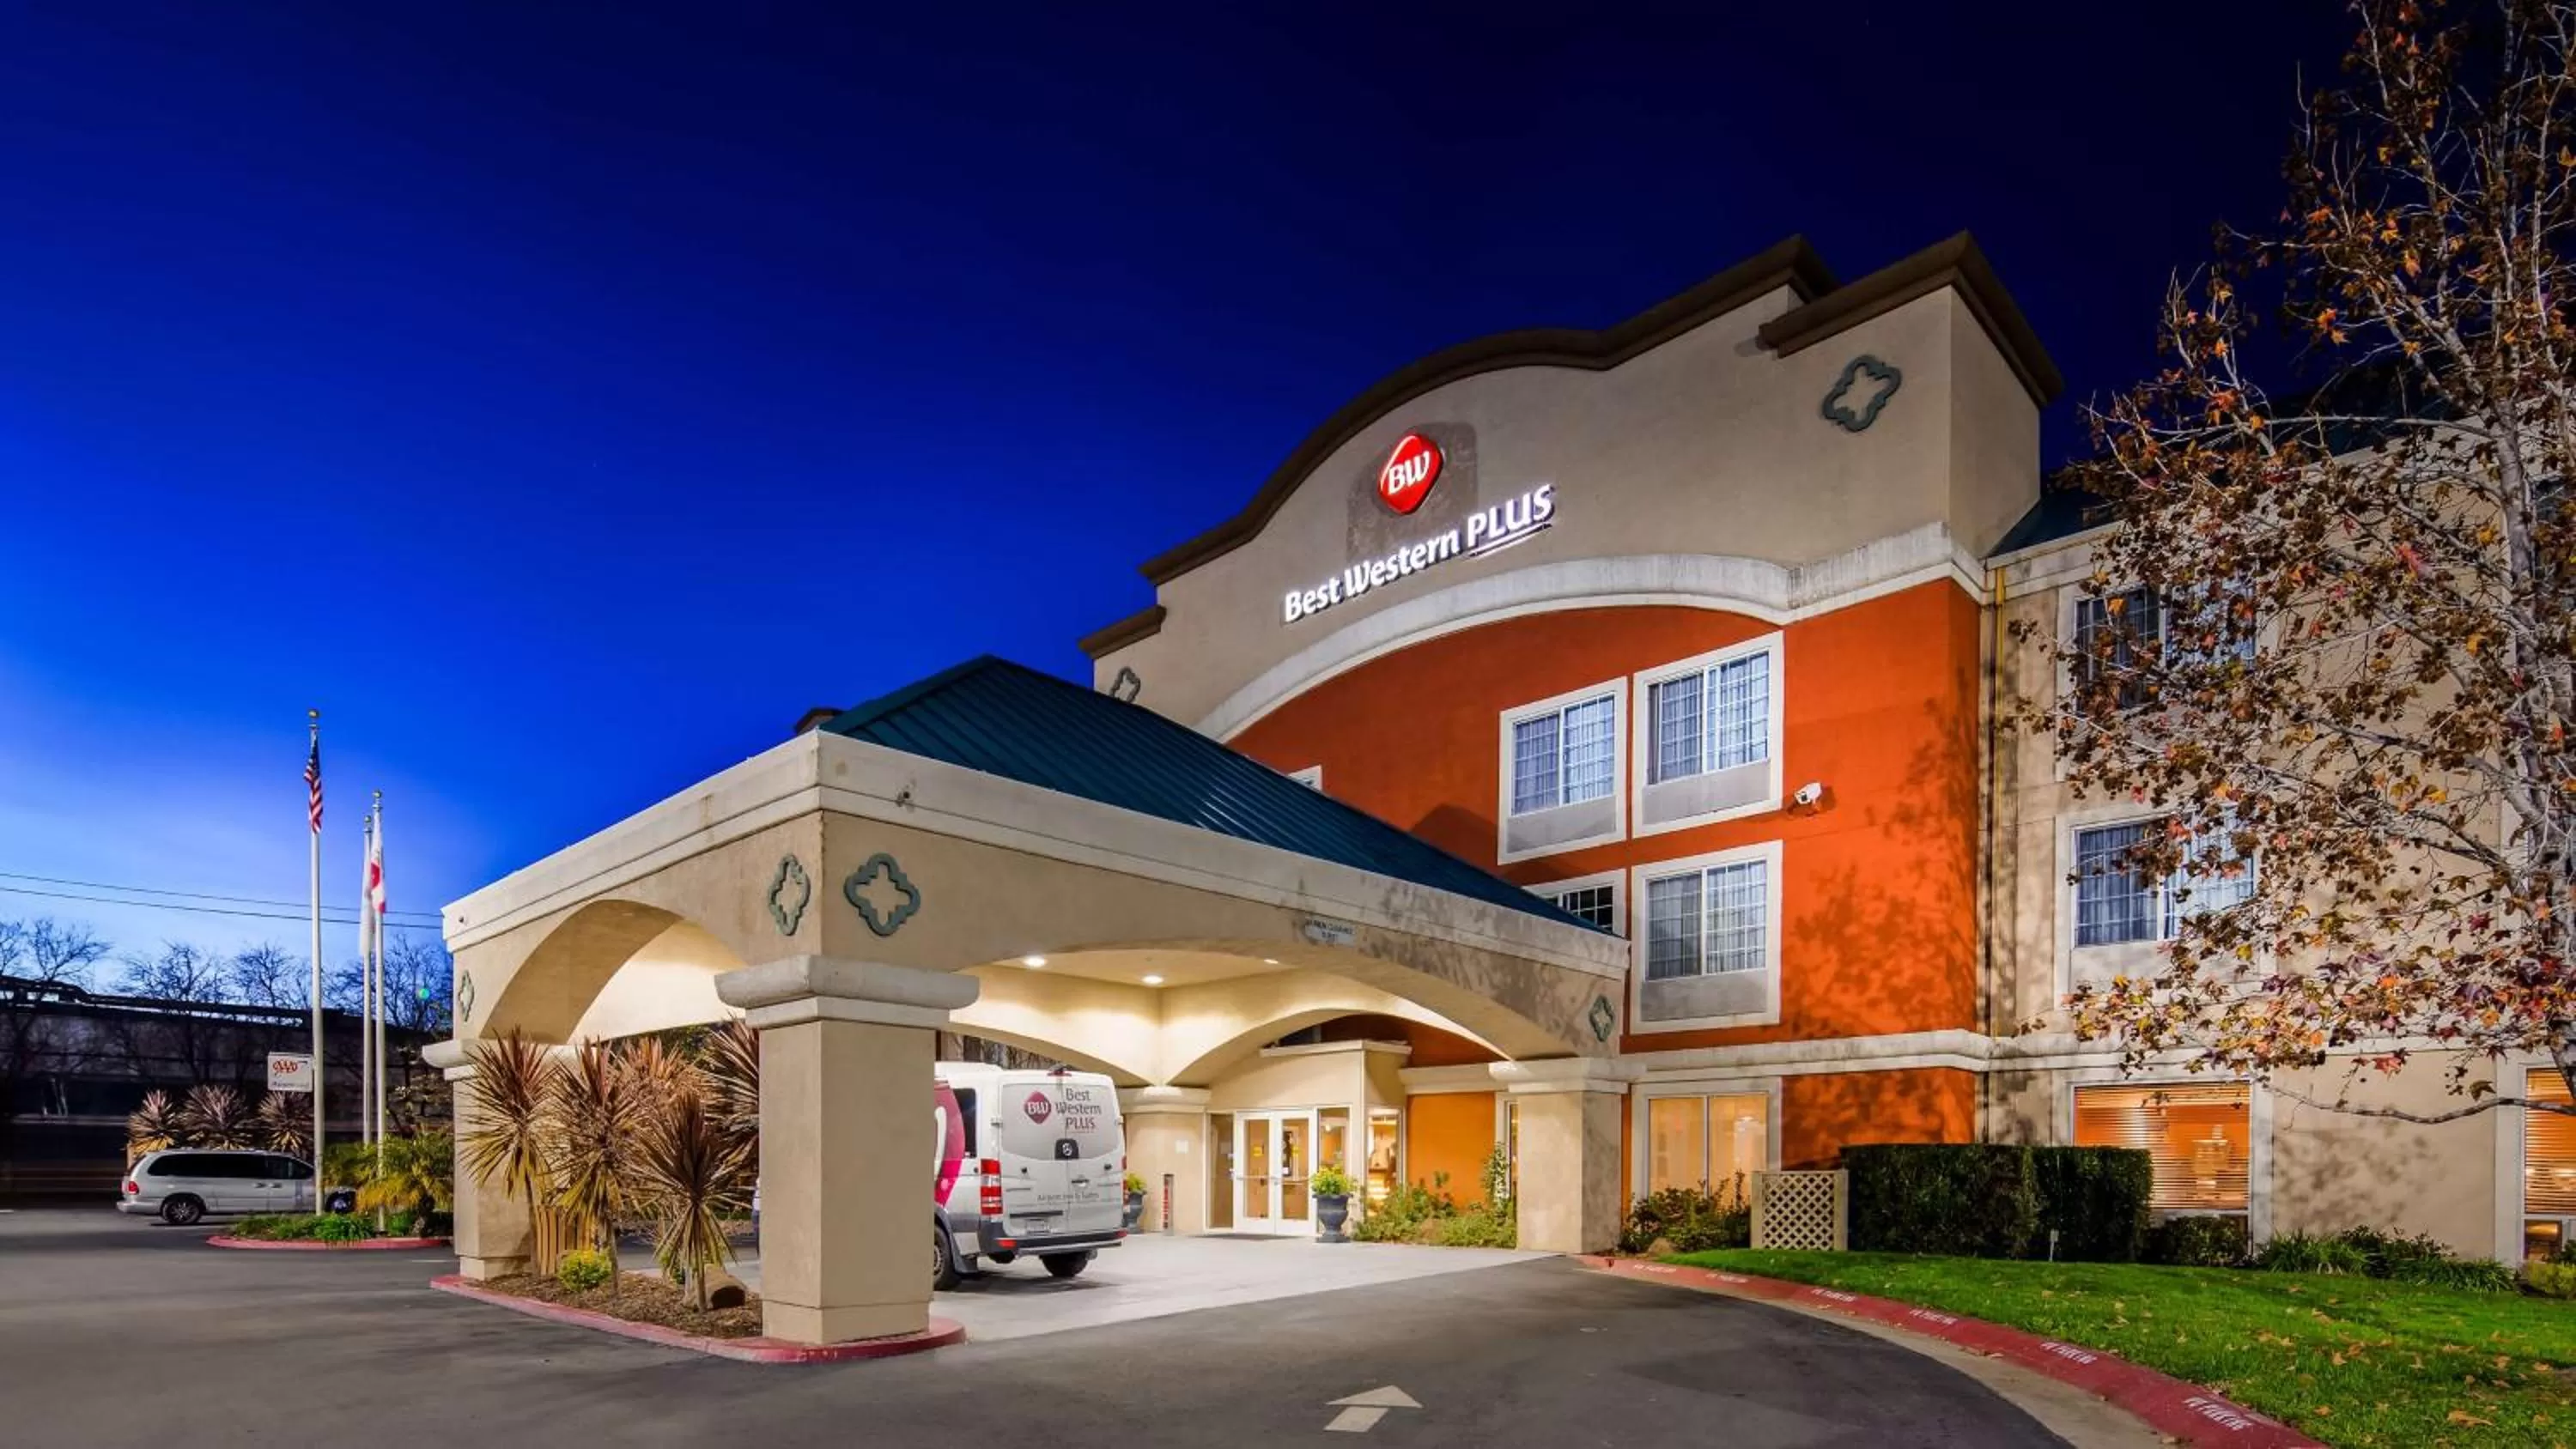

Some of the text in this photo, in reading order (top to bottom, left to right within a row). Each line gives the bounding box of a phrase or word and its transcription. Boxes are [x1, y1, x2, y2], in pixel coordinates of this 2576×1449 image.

[1387, 451, 1431, 495] BW
[1285, 484, 1555, 622] Best Western PLUS
[1066, 1088, 1091, 1101] Best
[1027, 1101, 1048, 1115] BW
[1055, 1101, 1102, 1115] Western
[1066, 1117, 1096, 1130] PLUS
